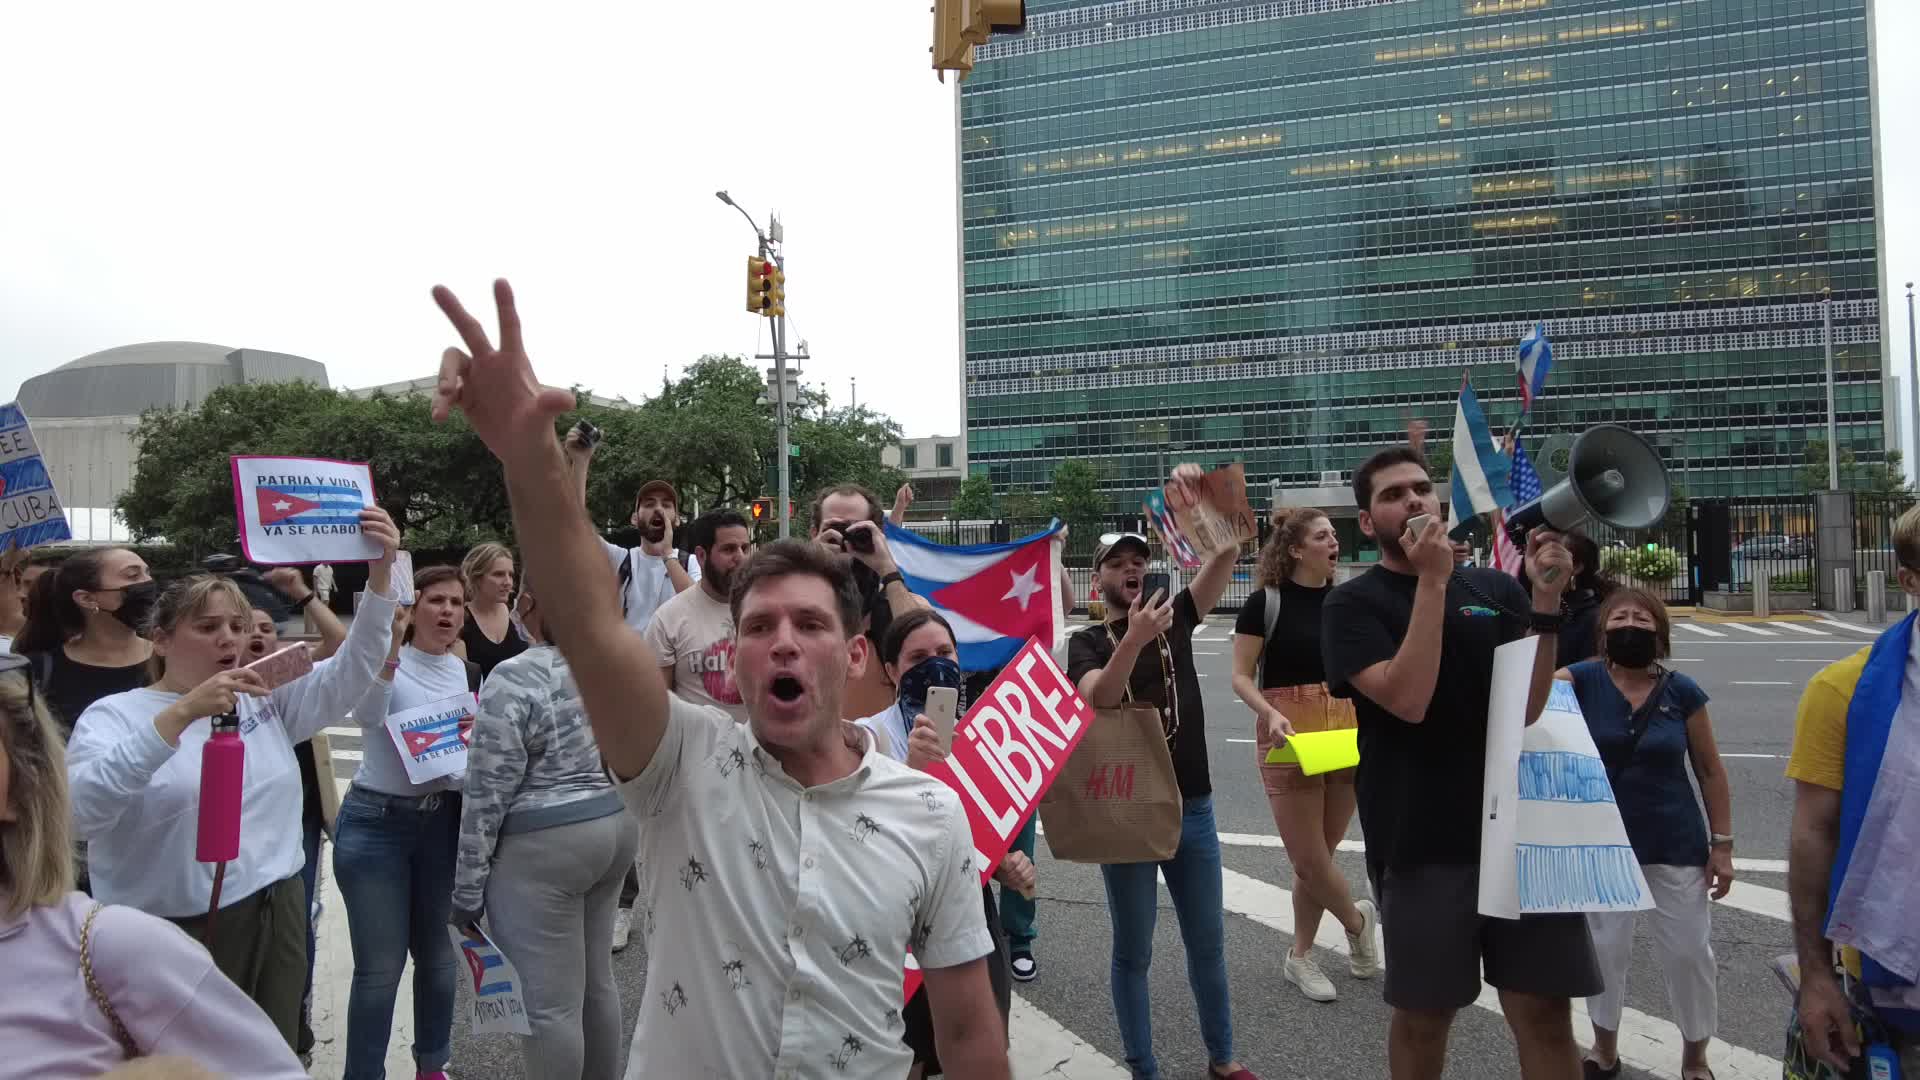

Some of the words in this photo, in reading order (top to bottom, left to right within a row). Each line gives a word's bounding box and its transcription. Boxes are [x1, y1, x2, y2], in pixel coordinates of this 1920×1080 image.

[0, 431, 28, 455] EE
[257, 475, 312, 486] PATRIA
[316, 476, 325, 486] Y
[329, 477, 359, 489] VIDA
[1, 495, 61, 530] CUBA
[263, 526, 283, 537] YA
[288, 525, 307, 536] SE
[400, 716, 434, 730] PATRIA
[445, 707, 468, 719] VIDA
[414, 754, 428, 765] YA
[443, 745, 465, 756] ACAB
